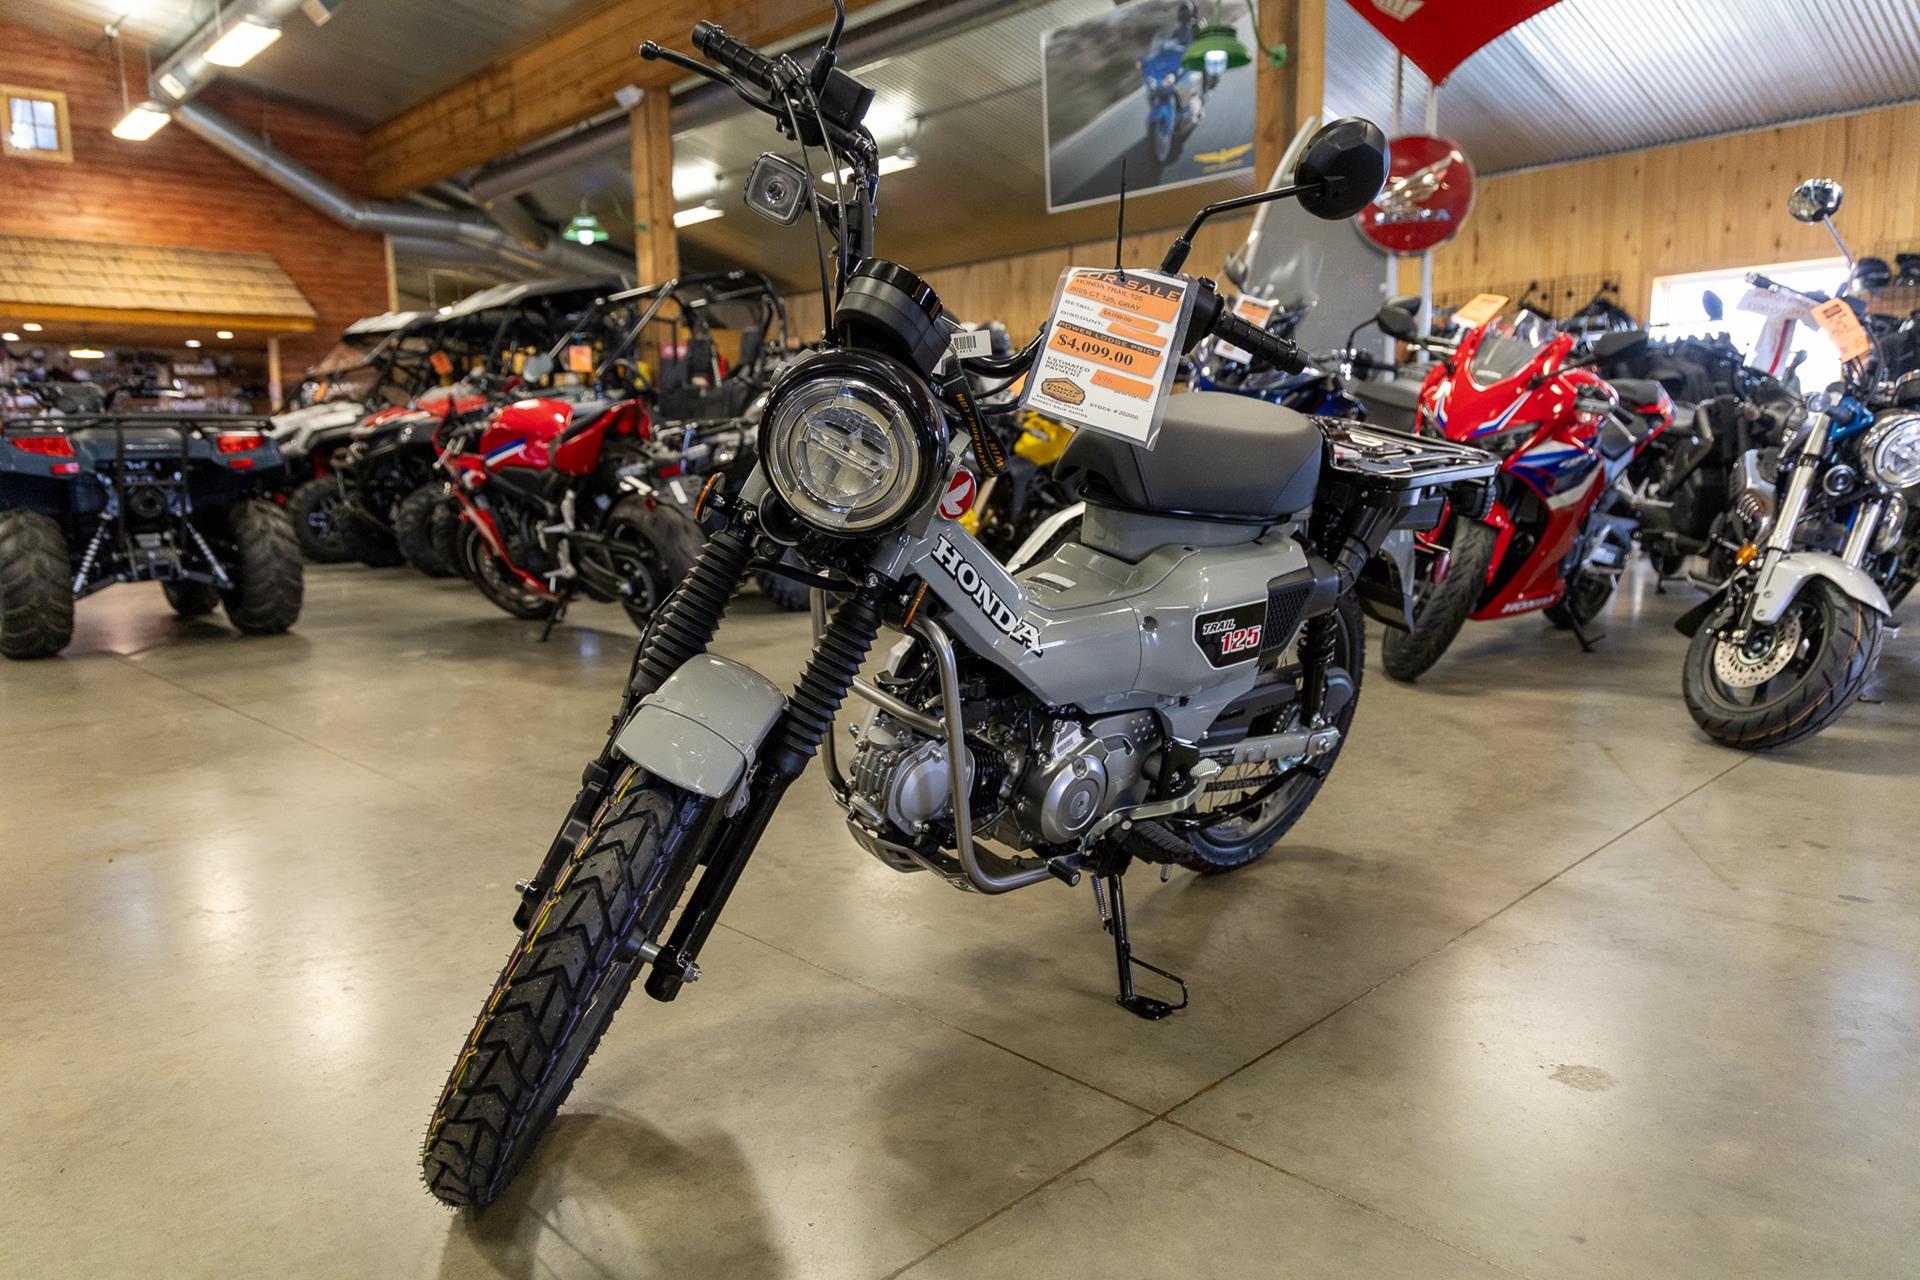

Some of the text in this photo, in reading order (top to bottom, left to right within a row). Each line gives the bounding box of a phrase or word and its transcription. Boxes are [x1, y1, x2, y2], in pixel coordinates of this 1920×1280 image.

[1070, 286, 1087, 295] 2025
[1118, 299, 1141, 311] GRAY
[1076, 279, 1143, 302] HONDA TRAIL 125
[1124, 279, 1181, 302] SALE
[1060, 310, 1103, 327] DISCOUNT:
[1057, 334, 1133, 366] $4,099.00
[1060, 322, 1160, 357] POWER LODGE PRICE
[1045, 364, 1080, 378] PAYMENT
[1046, 360, 1082, 374] MONTHLY
[1047, 356, 1090, 372] ESTIMATED
[931, 534, 1043, 658] HONDA
[1203, 619, 1236, 635] TRAIL
[1221, 625, 1262, 655] 125
